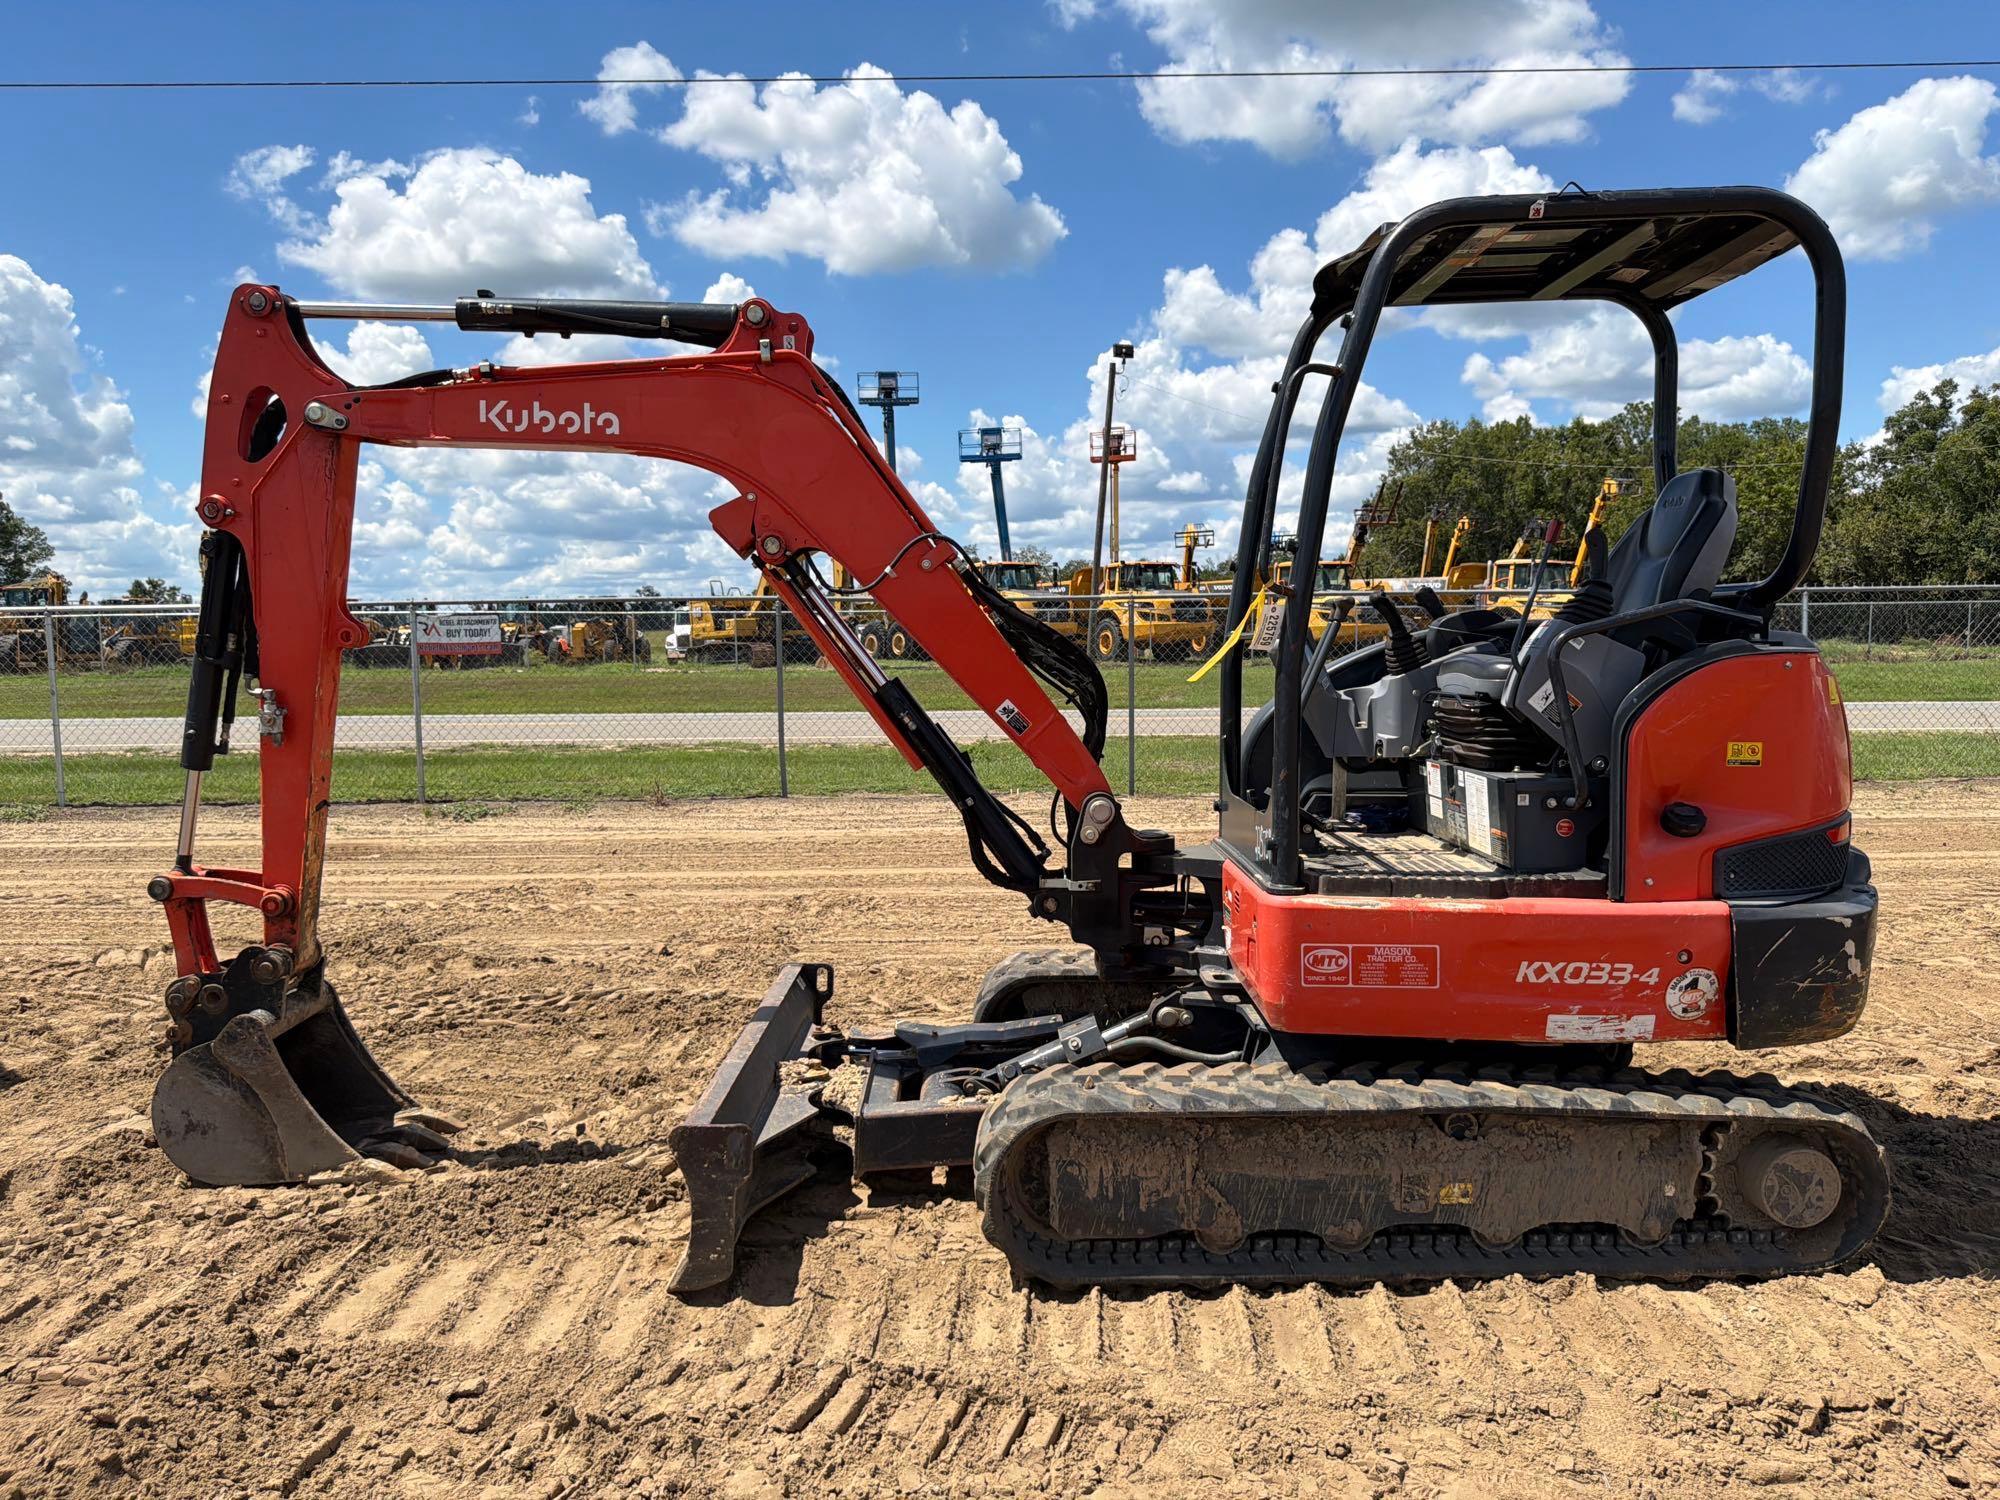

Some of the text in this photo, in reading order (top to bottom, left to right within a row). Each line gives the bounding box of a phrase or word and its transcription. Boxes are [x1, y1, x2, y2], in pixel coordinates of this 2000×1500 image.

[479, 399, 620, 435] Kubota
[446, 628, 491, 638] BUY TODAY!
[1260, 614, 1279, 647] 225759
[1374, 947, 1411, 956] MASON
[1404, 955, 1418, 963] CO.
[1311, 954, 1345, 968] MTC
[1515, 961, 1661, 986] KX033-4
[1670, 975, 1688, 991] MASON
